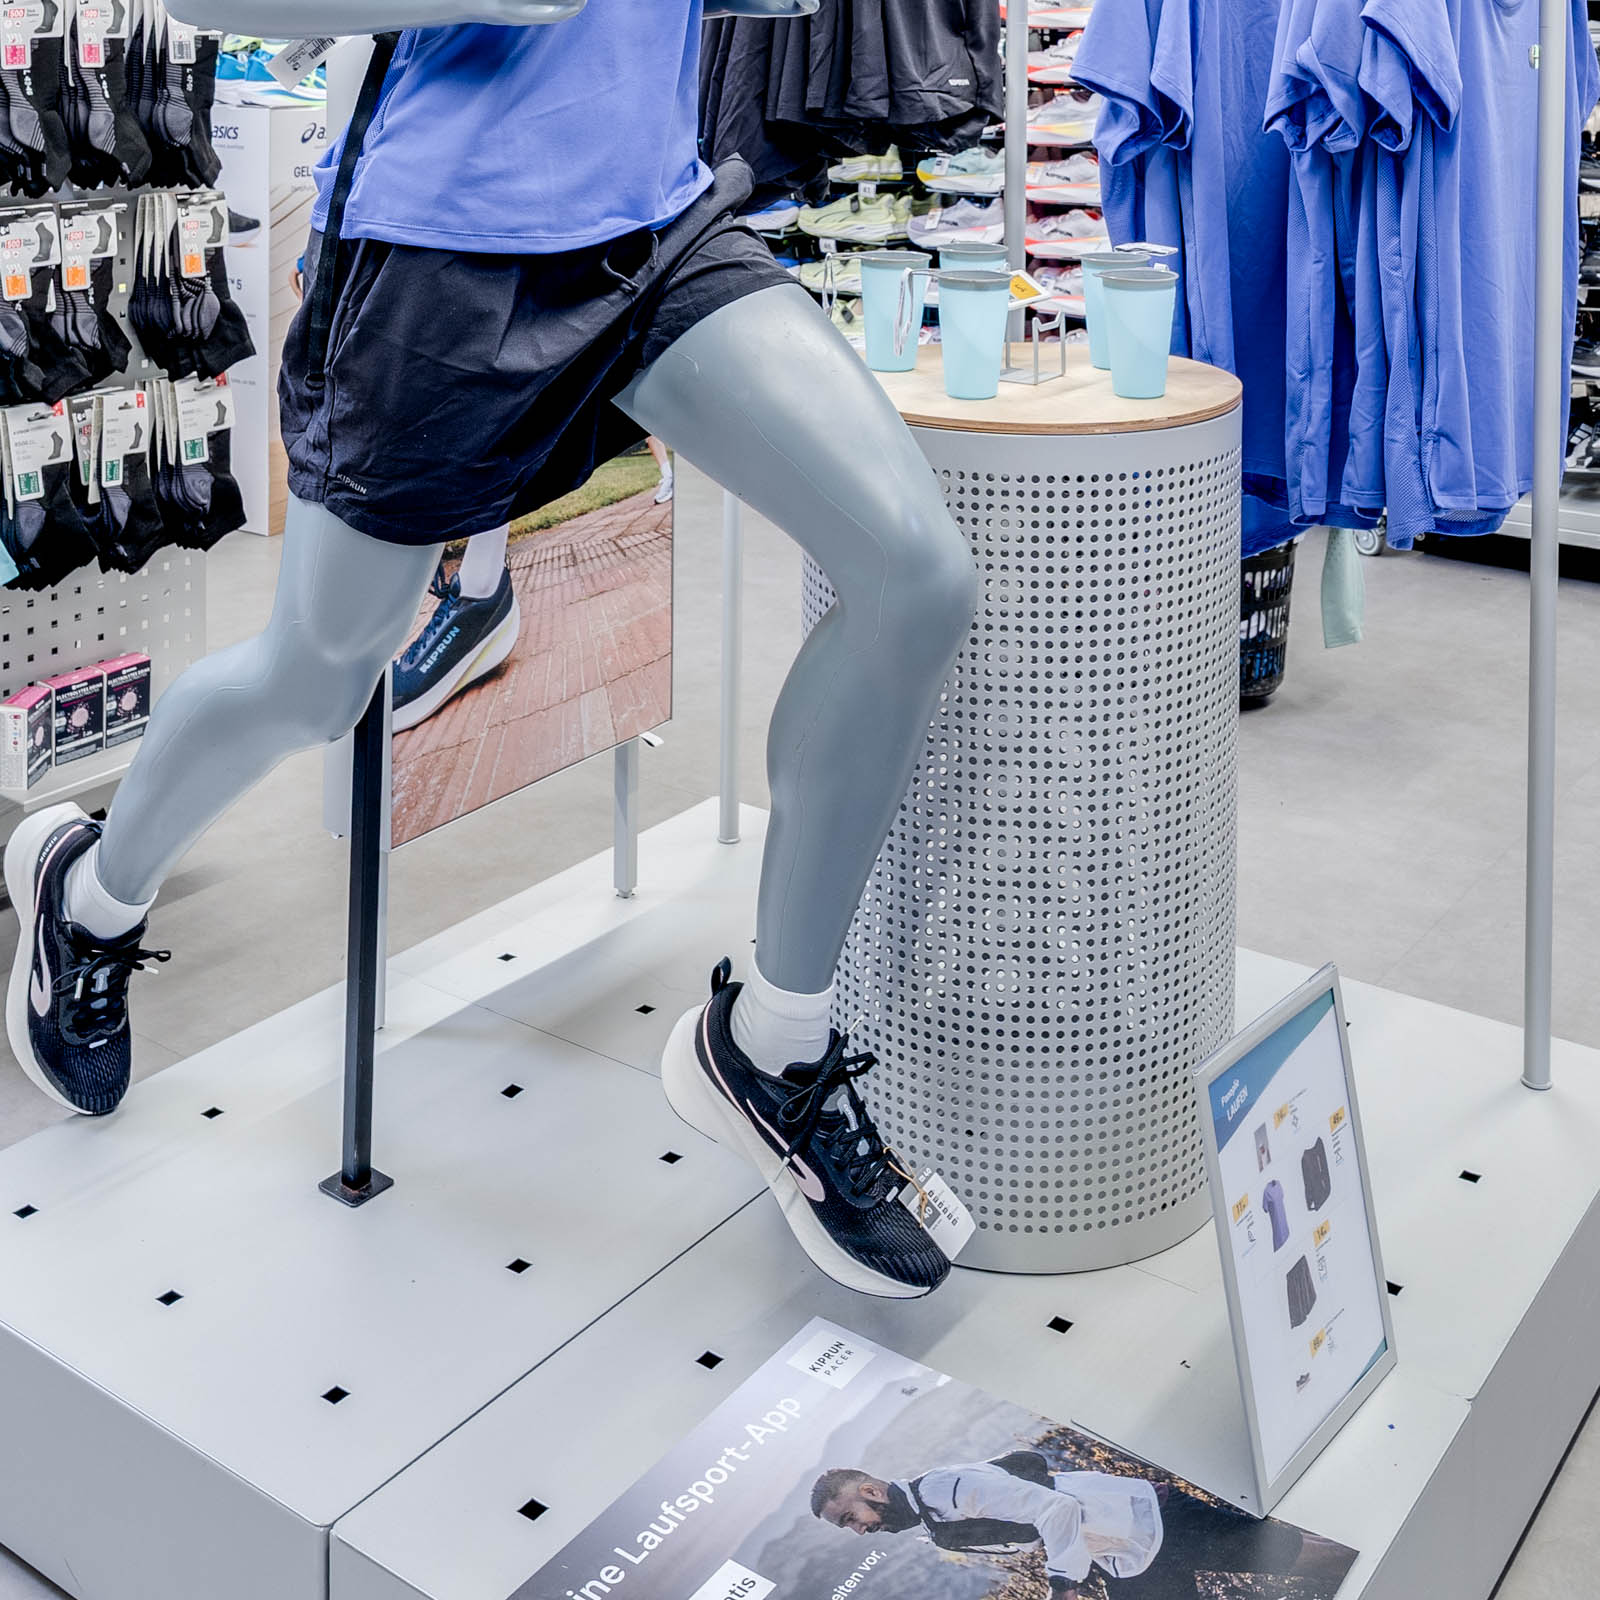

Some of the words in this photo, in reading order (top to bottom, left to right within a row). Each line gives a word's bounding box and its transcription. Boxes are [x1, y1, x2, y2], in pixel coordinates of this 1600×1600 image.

[337, 473, 367, 495] KIPRUN
[419, 625, 461, 674] KIPRUN
[1226, 1085, 1248, 1122] LAUFEN
[808, 1340, 845, 1373] KIPRUN
[824, 1349, 855, 1377] PACER
[614, 1396, 801, 1565] Laufsport-App
[858, 1550, 887, 1571] vor,
